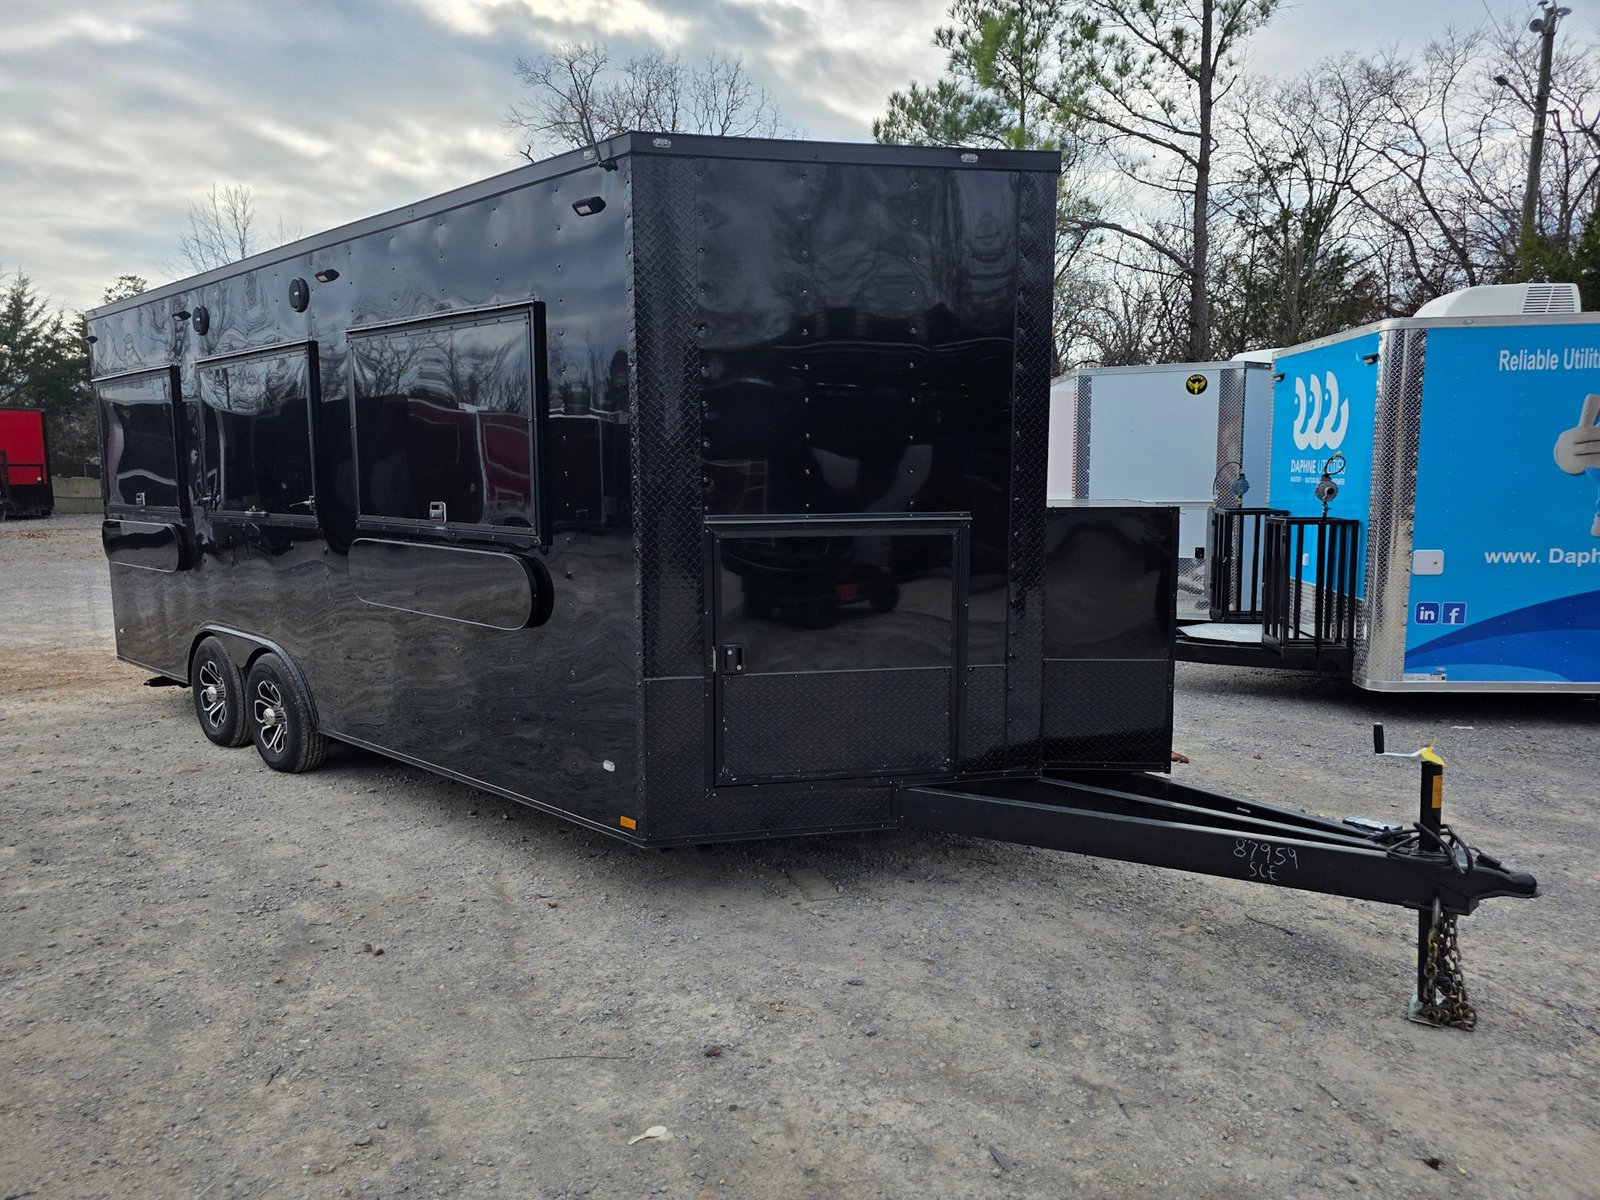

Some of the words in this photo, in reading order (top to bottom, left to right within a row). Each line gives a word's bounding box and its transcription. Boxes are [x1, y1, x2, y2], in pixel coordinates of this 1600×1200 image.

[1499, 348, 1559, 371] Reliable
[1290, 459, 1317, 474] DAPHNE
[1484, 551, 1541, 564] www.
[1419, 606, 1435, 621] in
[1233, 838, 1298, 870] 87959
